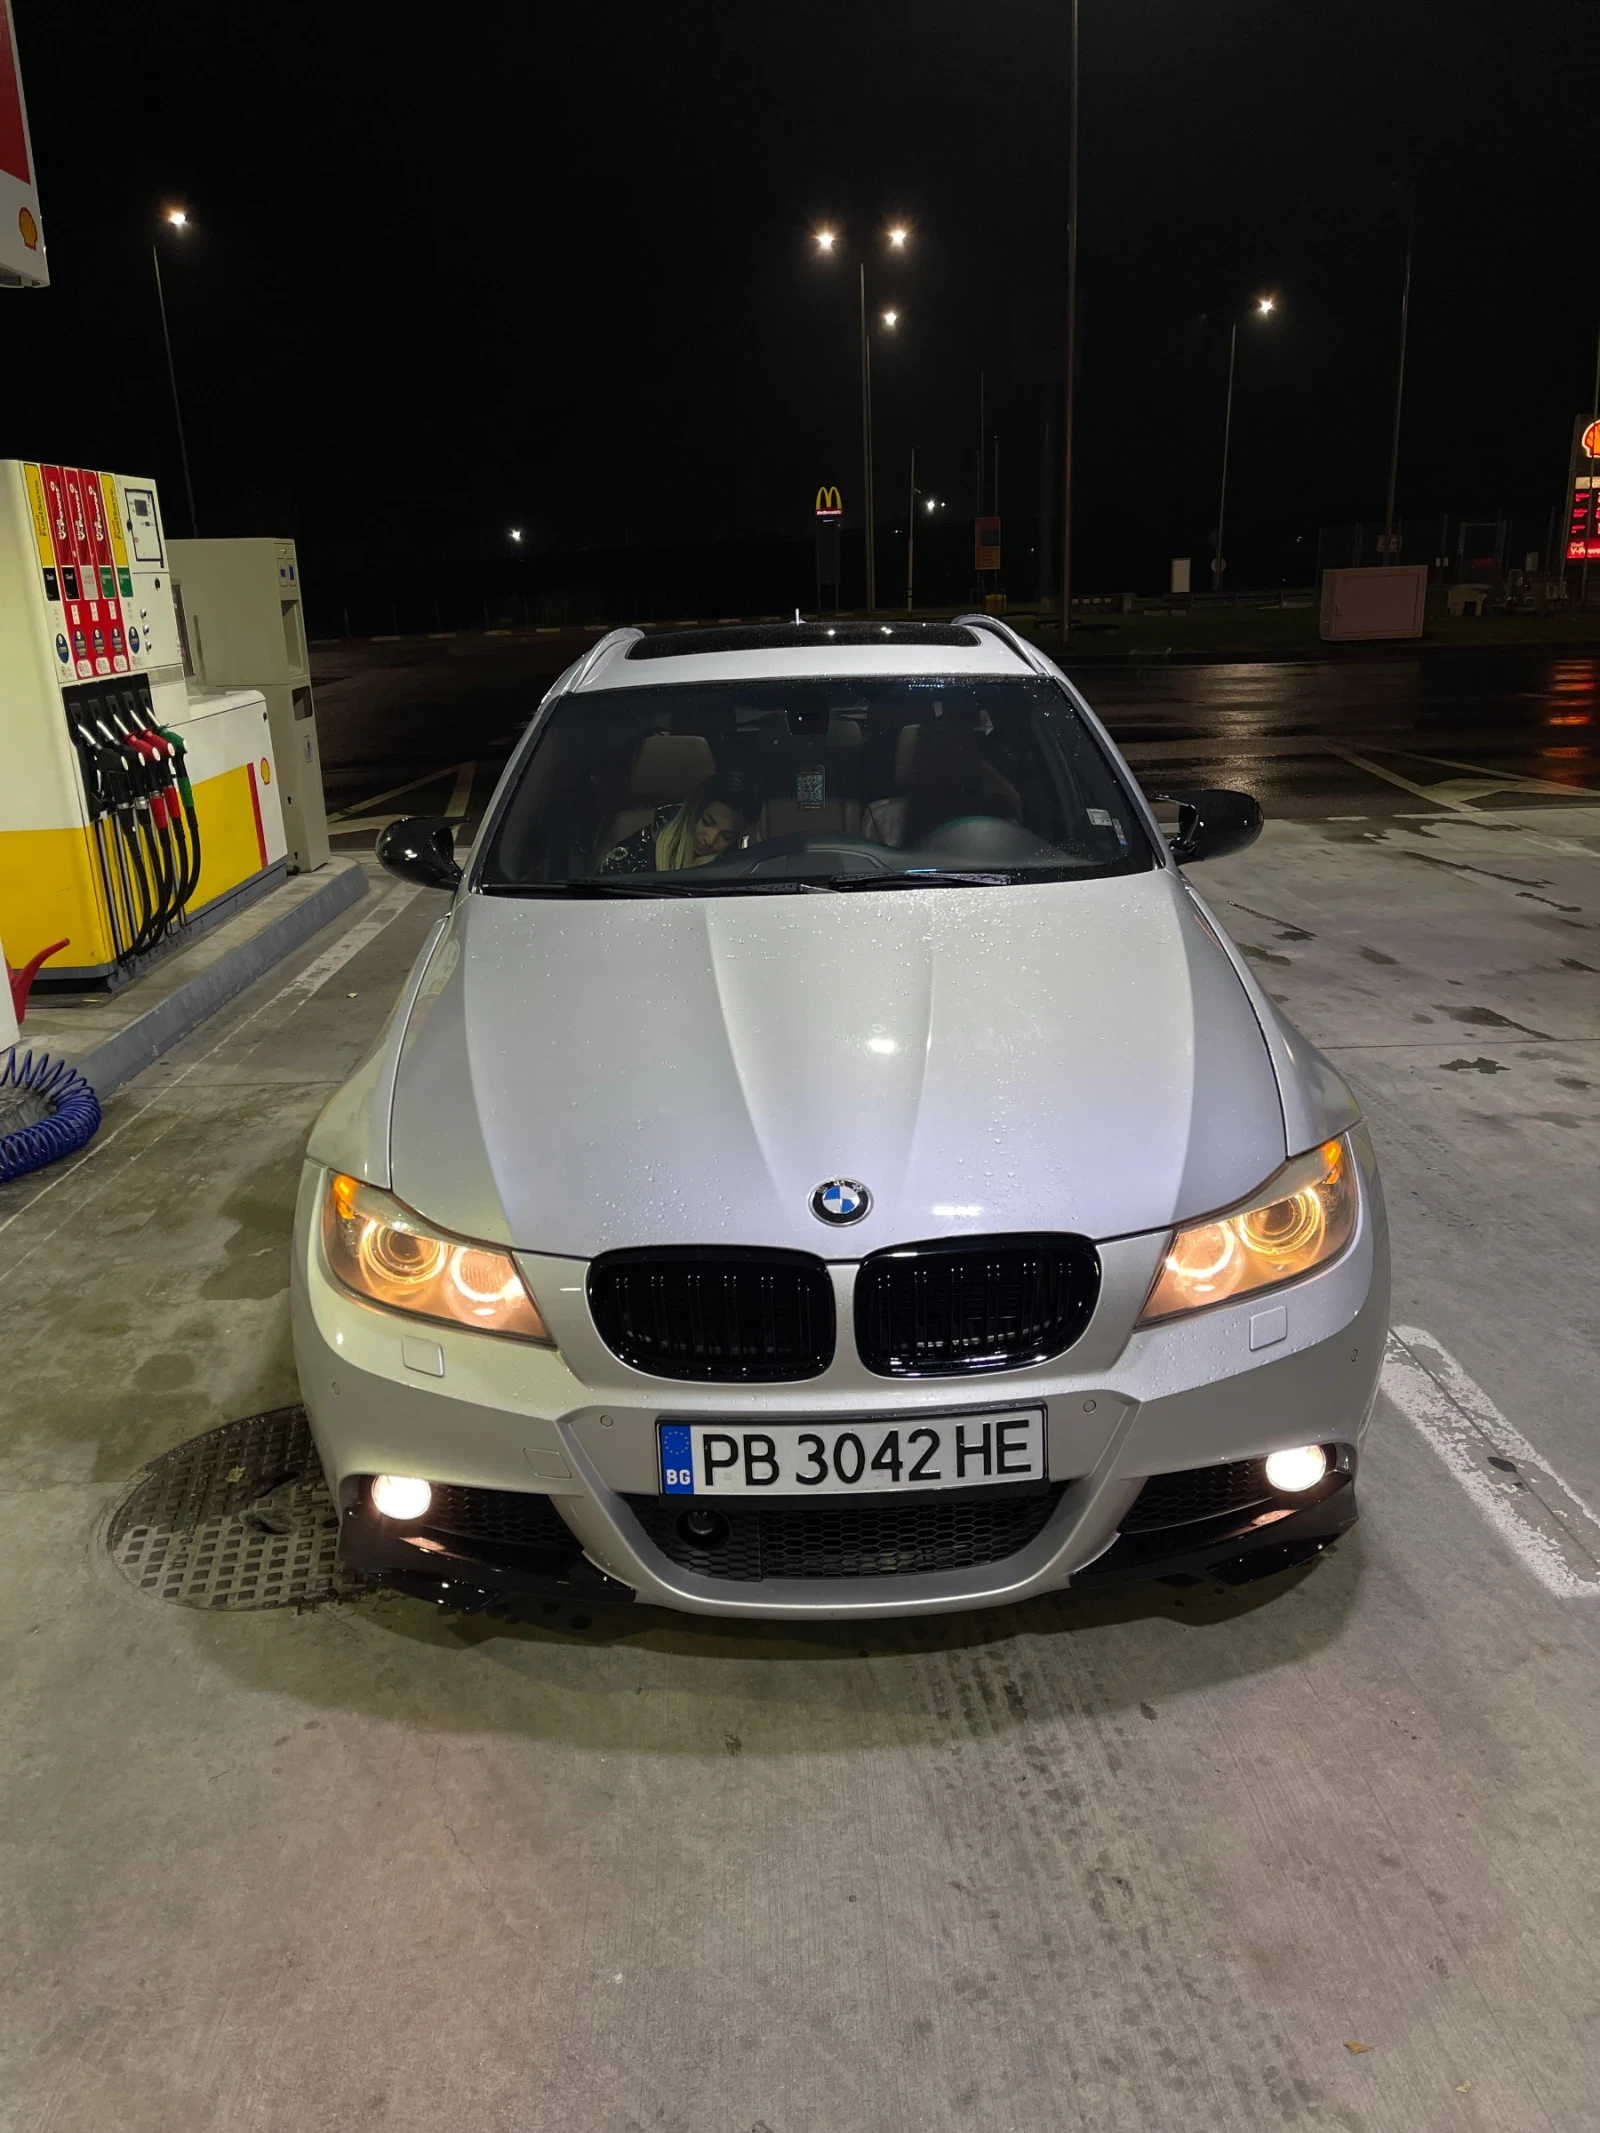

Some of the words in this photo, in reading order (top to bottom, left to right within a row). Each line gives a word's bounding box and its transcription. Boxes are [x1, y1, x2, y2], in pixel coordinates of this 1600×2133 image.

[703, 1434, 779, 1485] PB
[796, 1427, 941, 1485] 3042
[956, 1419, 1032, 1479] HE
[666, 1469, 691, 1485] BG
